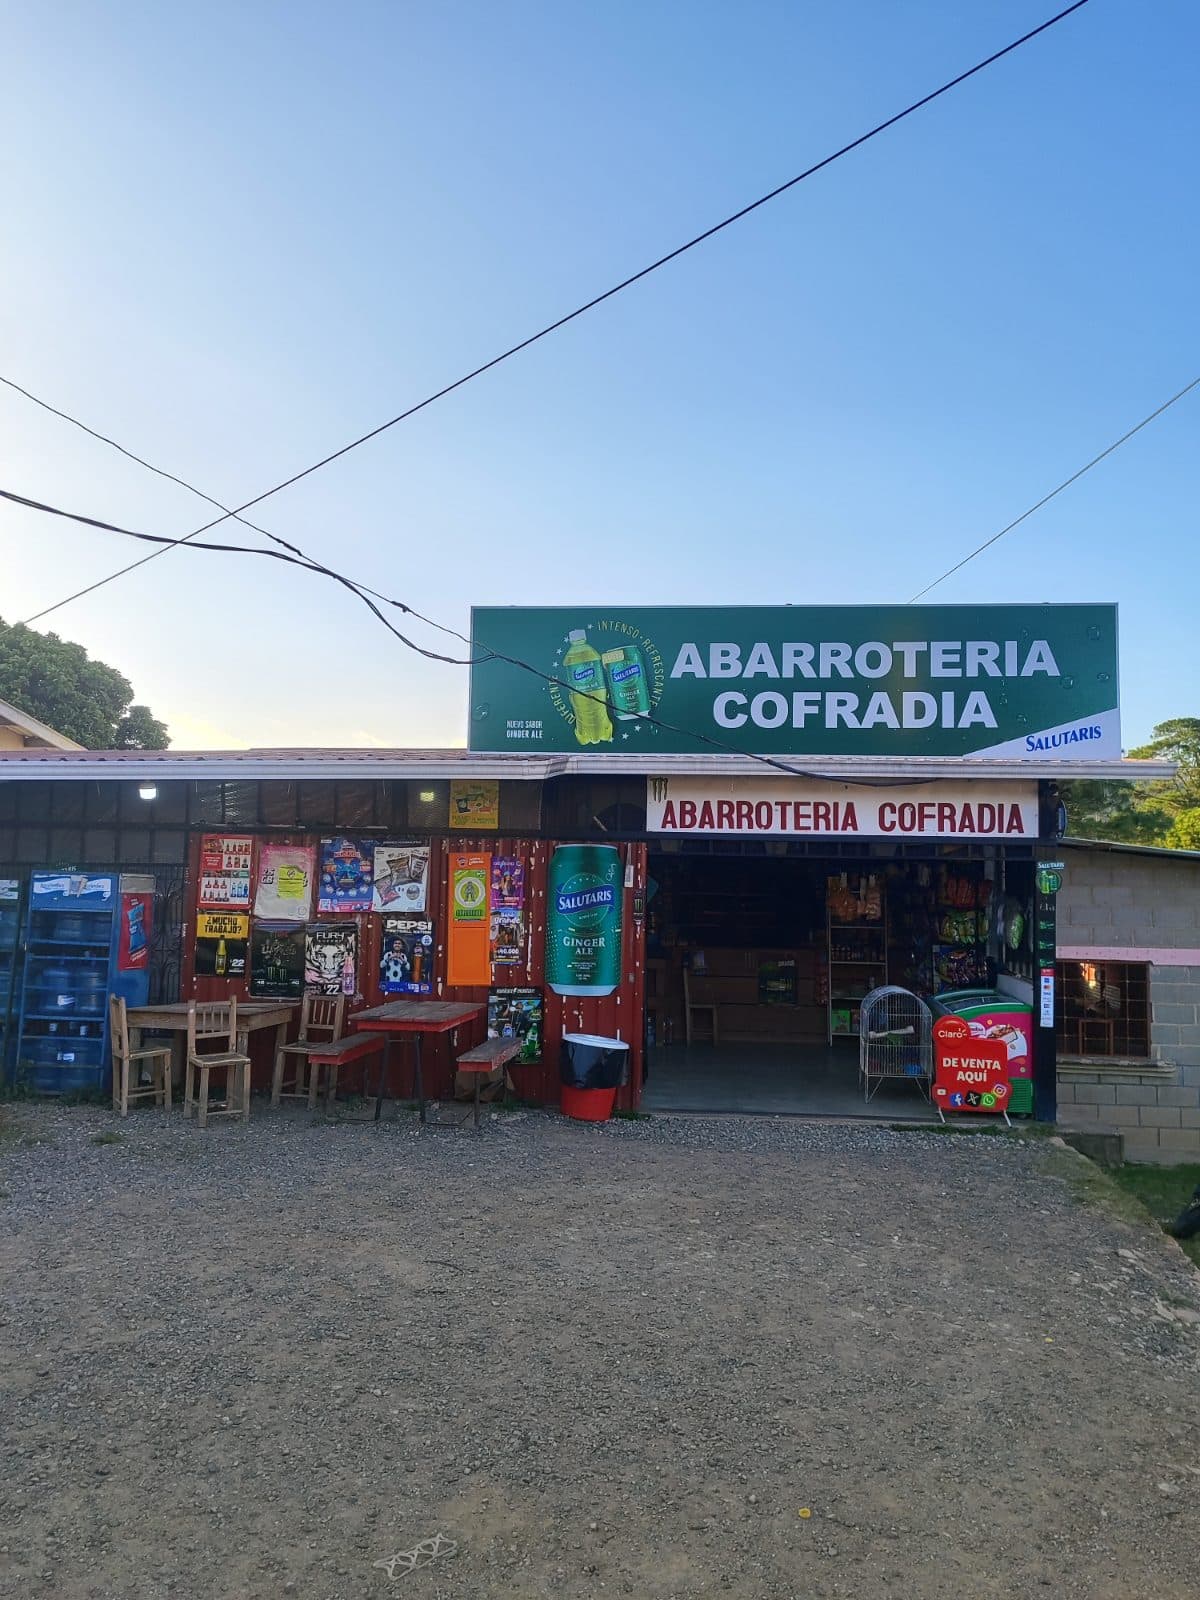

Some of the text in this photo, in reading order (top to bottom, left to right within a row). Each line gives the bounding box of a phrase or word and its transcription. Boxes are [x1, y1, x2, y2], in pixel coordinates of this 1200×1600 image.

[597, 620, 640, 638] INTENSO
[670, 640, 1061, 679] ABARROTERIA
[712, 690, 999, 729] COFRADIA
[531, 729, 544, 739] ALE
[1025, 725, 1102, 752] SALUTARIS
[660, 800, 1025, 834] ABARROTERIA COFRADIA
[559, 889, 612, 911] SALUTARIS
[206, 916, 238, 926] ¿MUCHO
[386, 919, 433, 931] PEPSI
[204, 925, 242, 934] TRABAJO?
[316, 931, 345, 941] FURY
[563, 936, 606, 948] GINGER
[575, 947, 594, 956] ALE
[938, 1029, 963, 1039] Claro
[942, 1057, 1001, 1071] DE VENTA
[956, 1070, 987, 1084] AQUÍ
